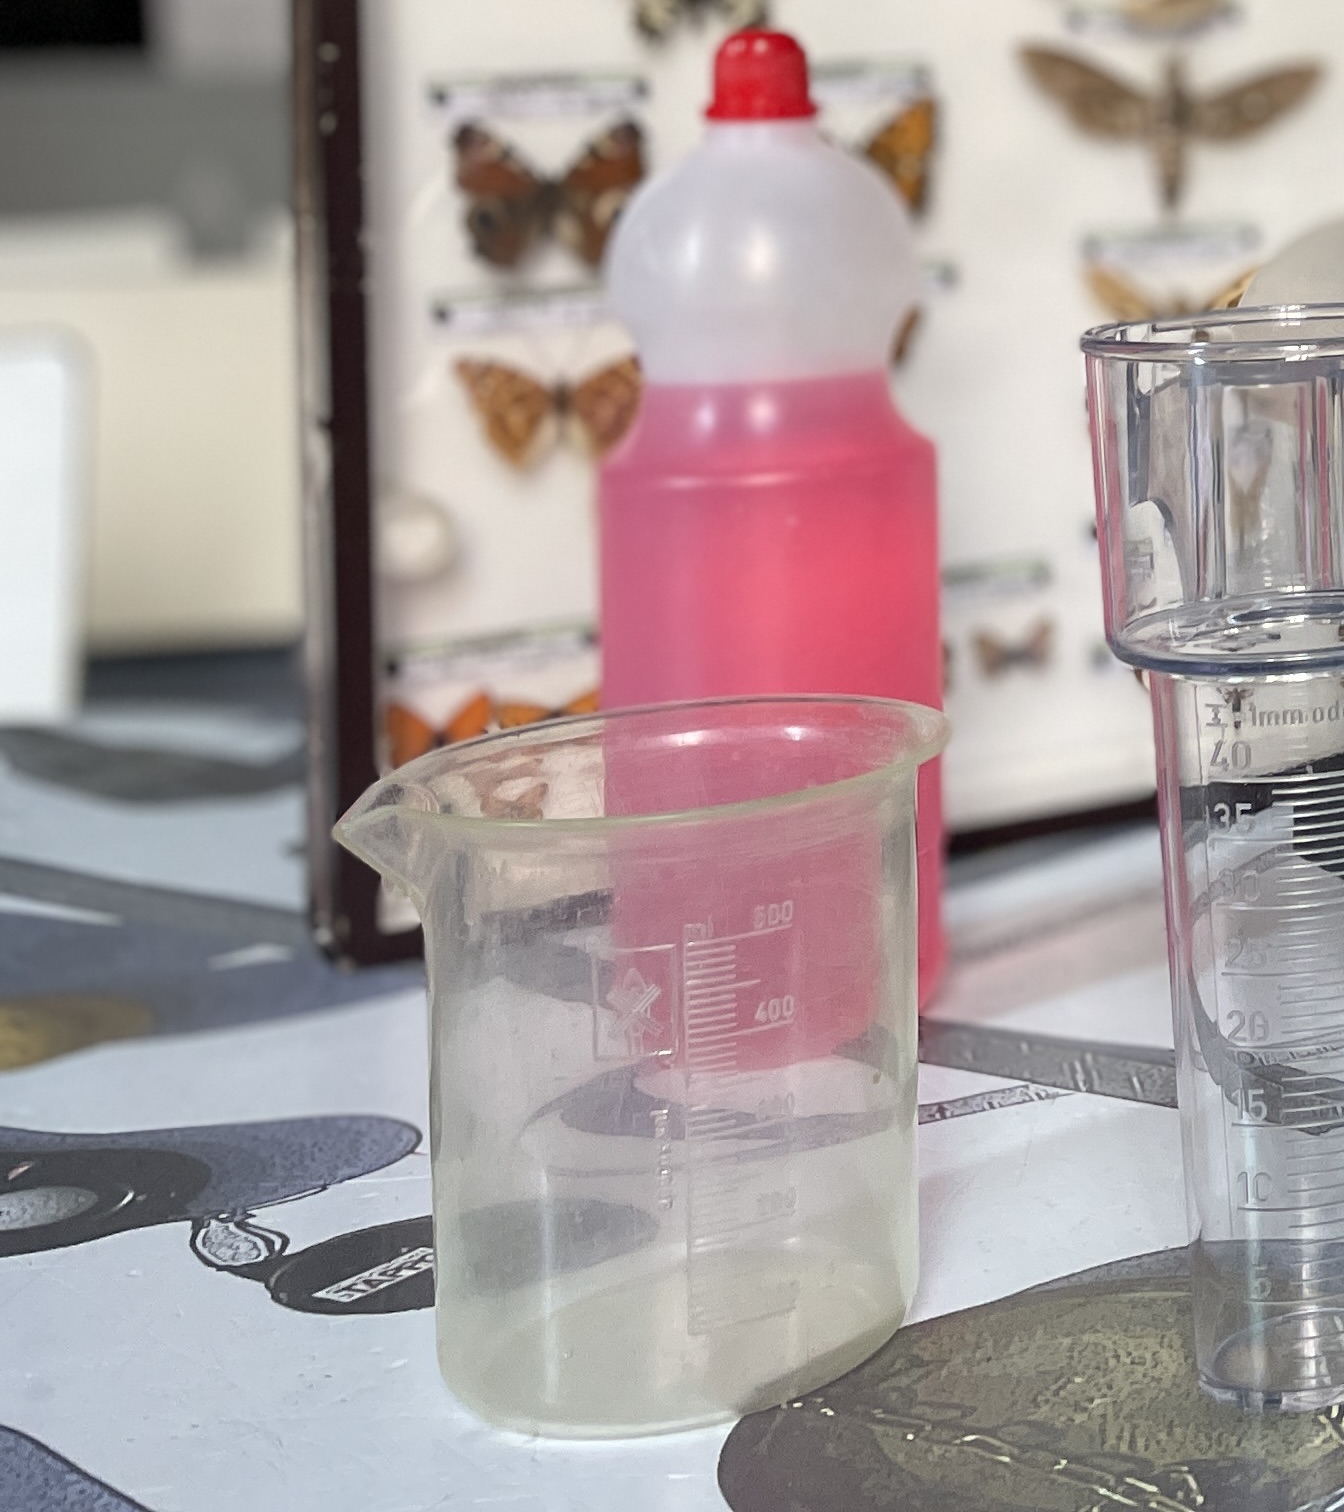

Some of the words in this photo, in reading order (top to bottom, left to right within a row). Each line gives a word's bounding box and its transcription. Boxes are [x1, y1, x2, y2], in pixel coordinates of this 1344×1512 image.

[1248, 701, 1305, 727] 1mm
[1210, 739, 1252, 772] 40
[755, 995, 795, 1023] 400
[1226, 1009, 1270, 1043] 20
[1231, 1088, 1268, 1122] 15
[1237, 1171, 1273, 1204] 10
